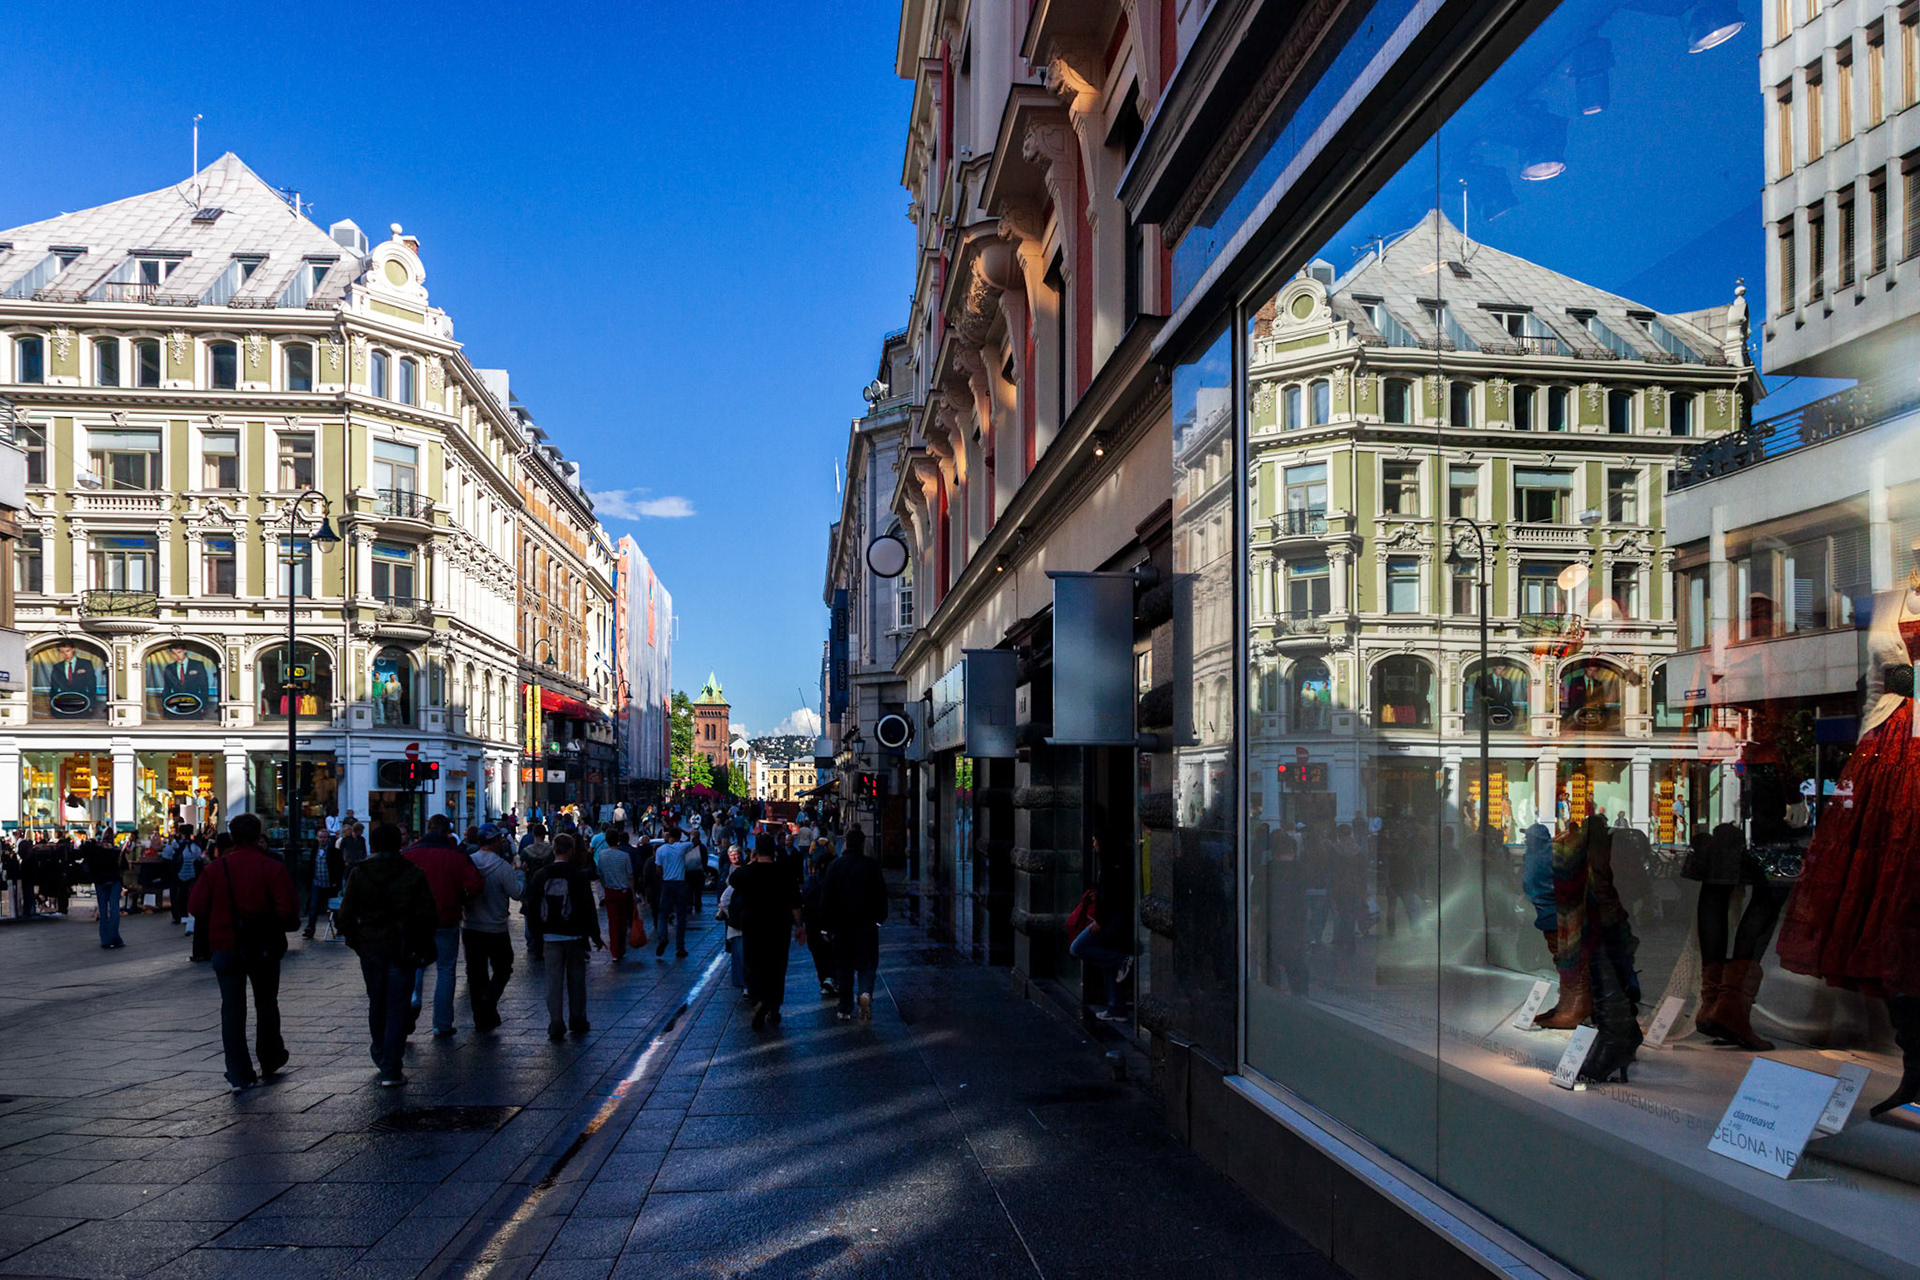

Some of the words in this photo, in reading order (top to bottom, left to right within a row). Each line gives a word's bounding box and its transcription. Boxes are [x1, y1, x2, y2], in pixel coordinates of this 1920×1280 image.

[1502, 1045, 1531, 1067] VIENNA
[1534, 1056, 1576, 1083] HELSINKI
[1578, 1074, 1607, 1096] PARIS
[1611, 1086, 1680, 1124] LUXEMBURG
[1732, 1109, 1776, 1132] dameavd.
